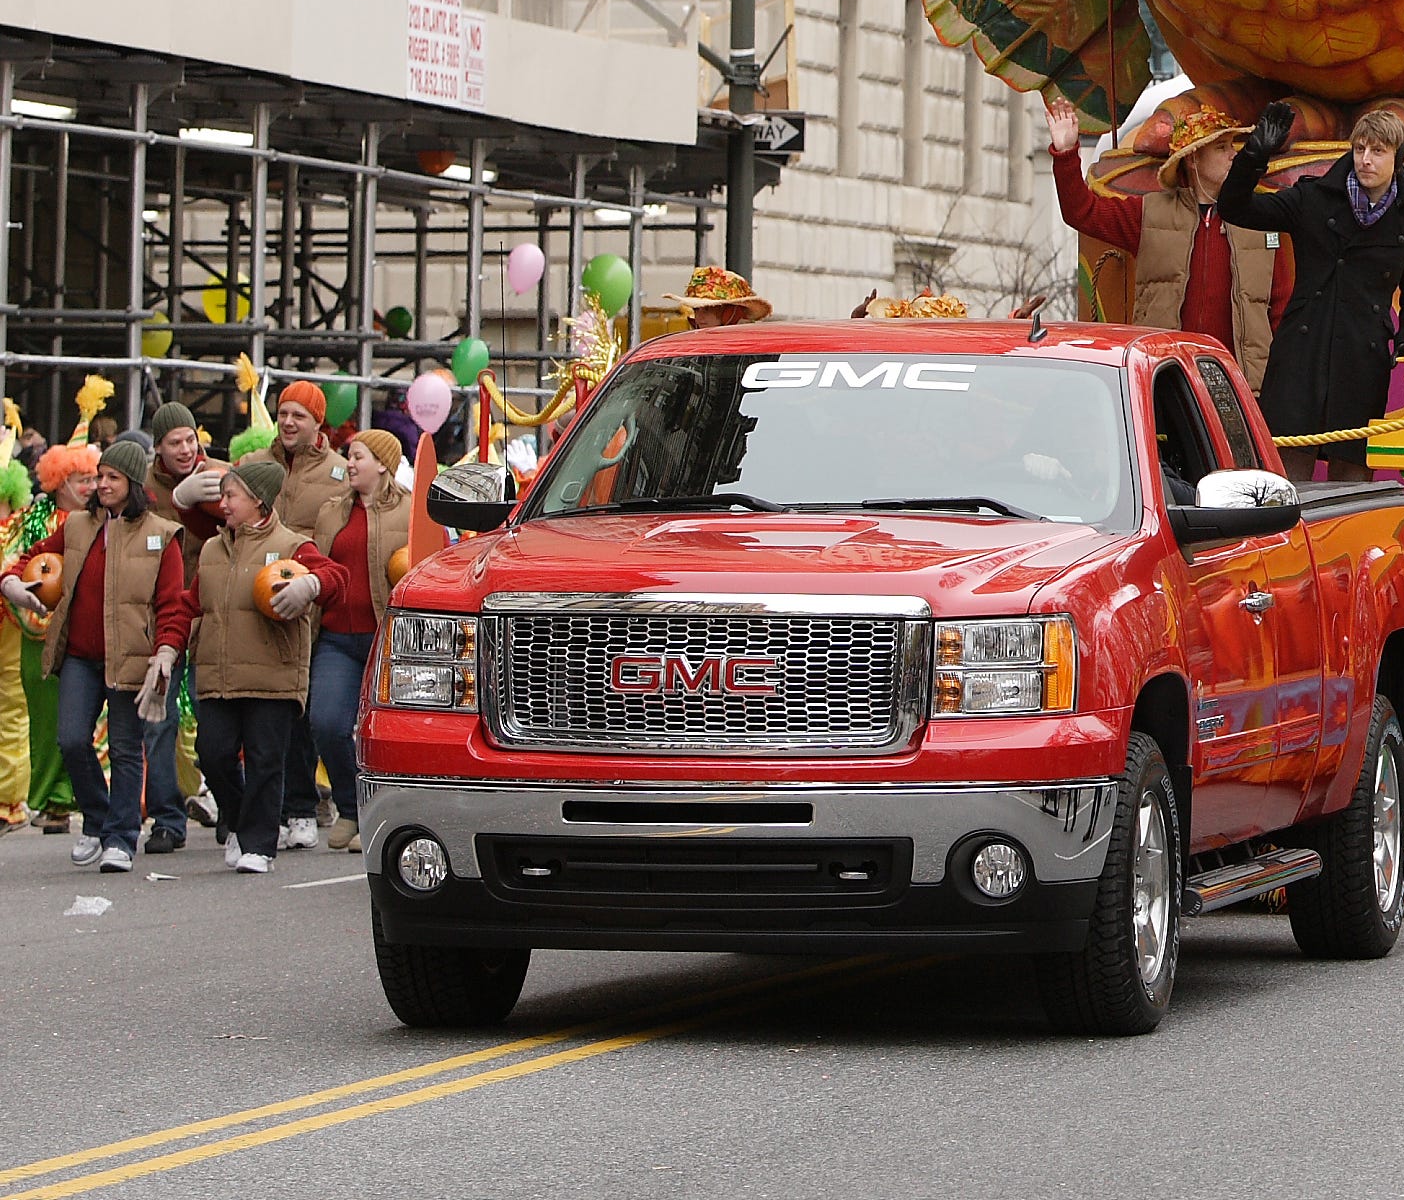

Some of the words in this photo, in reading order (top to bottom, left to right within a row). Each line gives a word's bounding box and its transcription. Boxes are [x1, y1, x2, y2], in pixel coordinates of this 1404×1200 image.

[423, 7, 447, 35] ATLANTIC
[470, 25, 481, 51] NO
[741, 361, 976, 392] GMC
[611, 655, 781, 695] GMC
